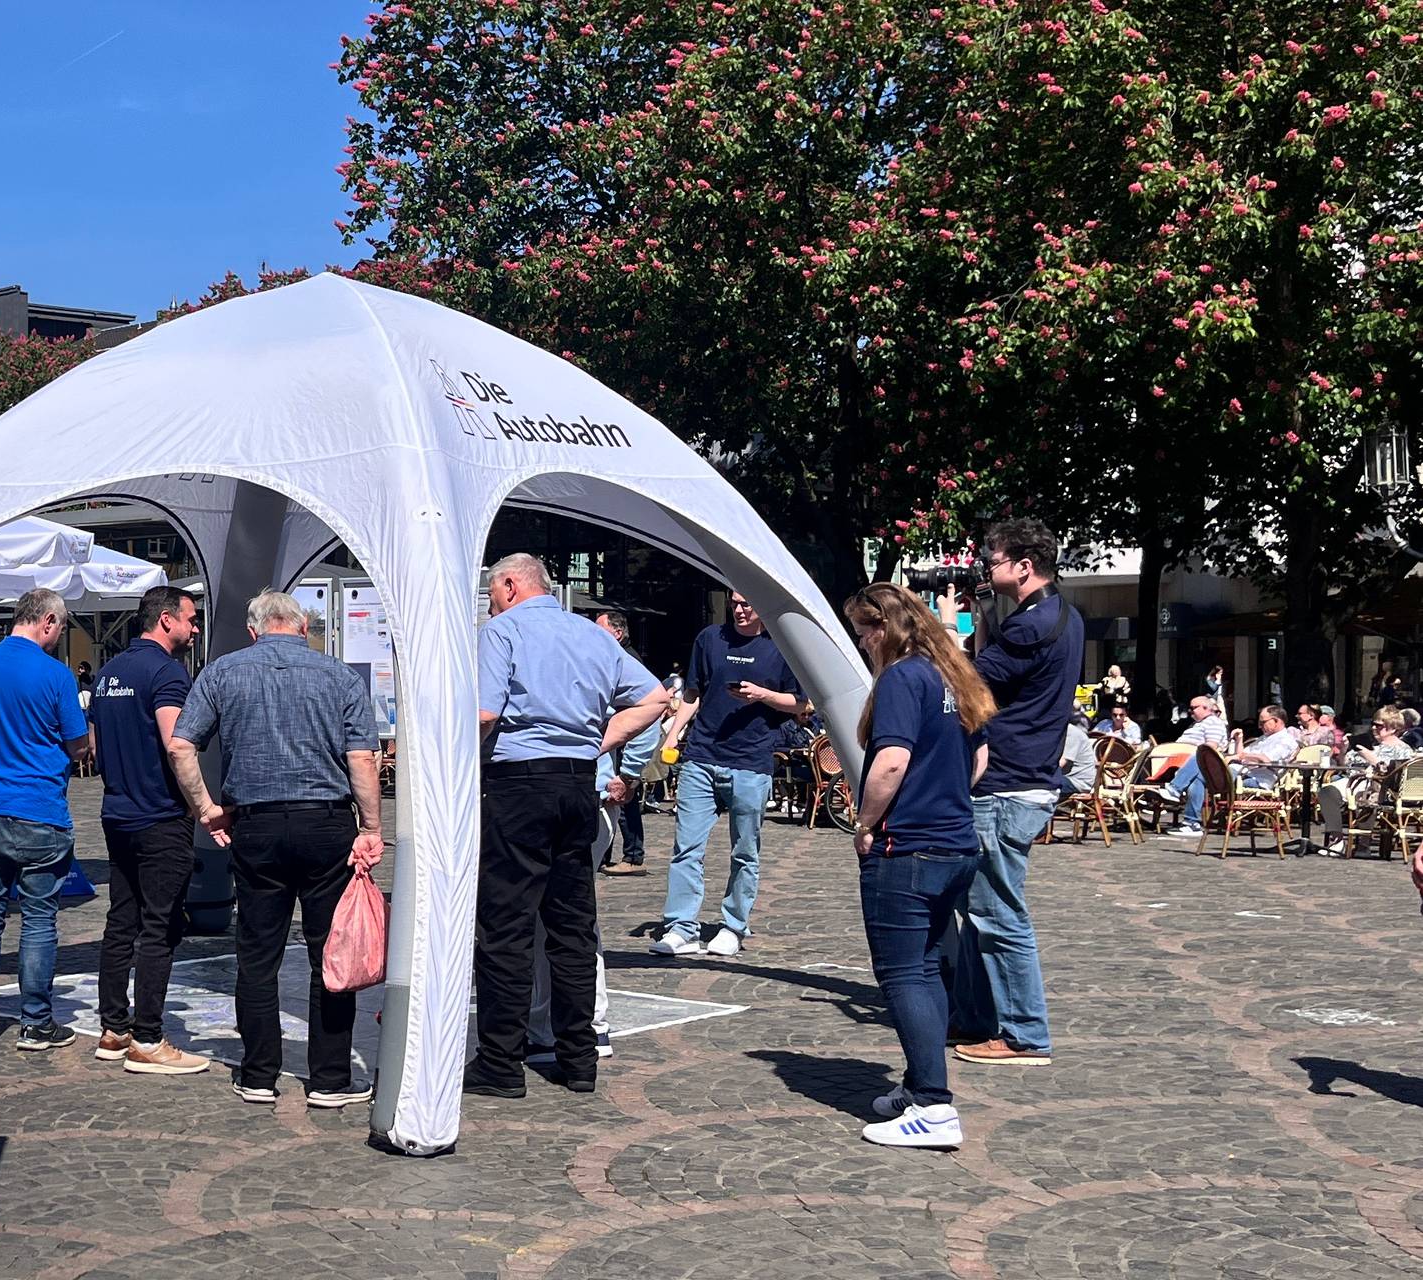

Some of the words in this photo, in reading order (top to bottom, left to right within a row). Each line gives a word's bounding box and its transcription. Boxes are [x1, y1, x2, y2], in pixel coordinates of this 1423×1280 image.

[460, 370, 513, 405] Die
[493, 412, 632, 448] Autobahn
[109, 676, 120, 686] Die
